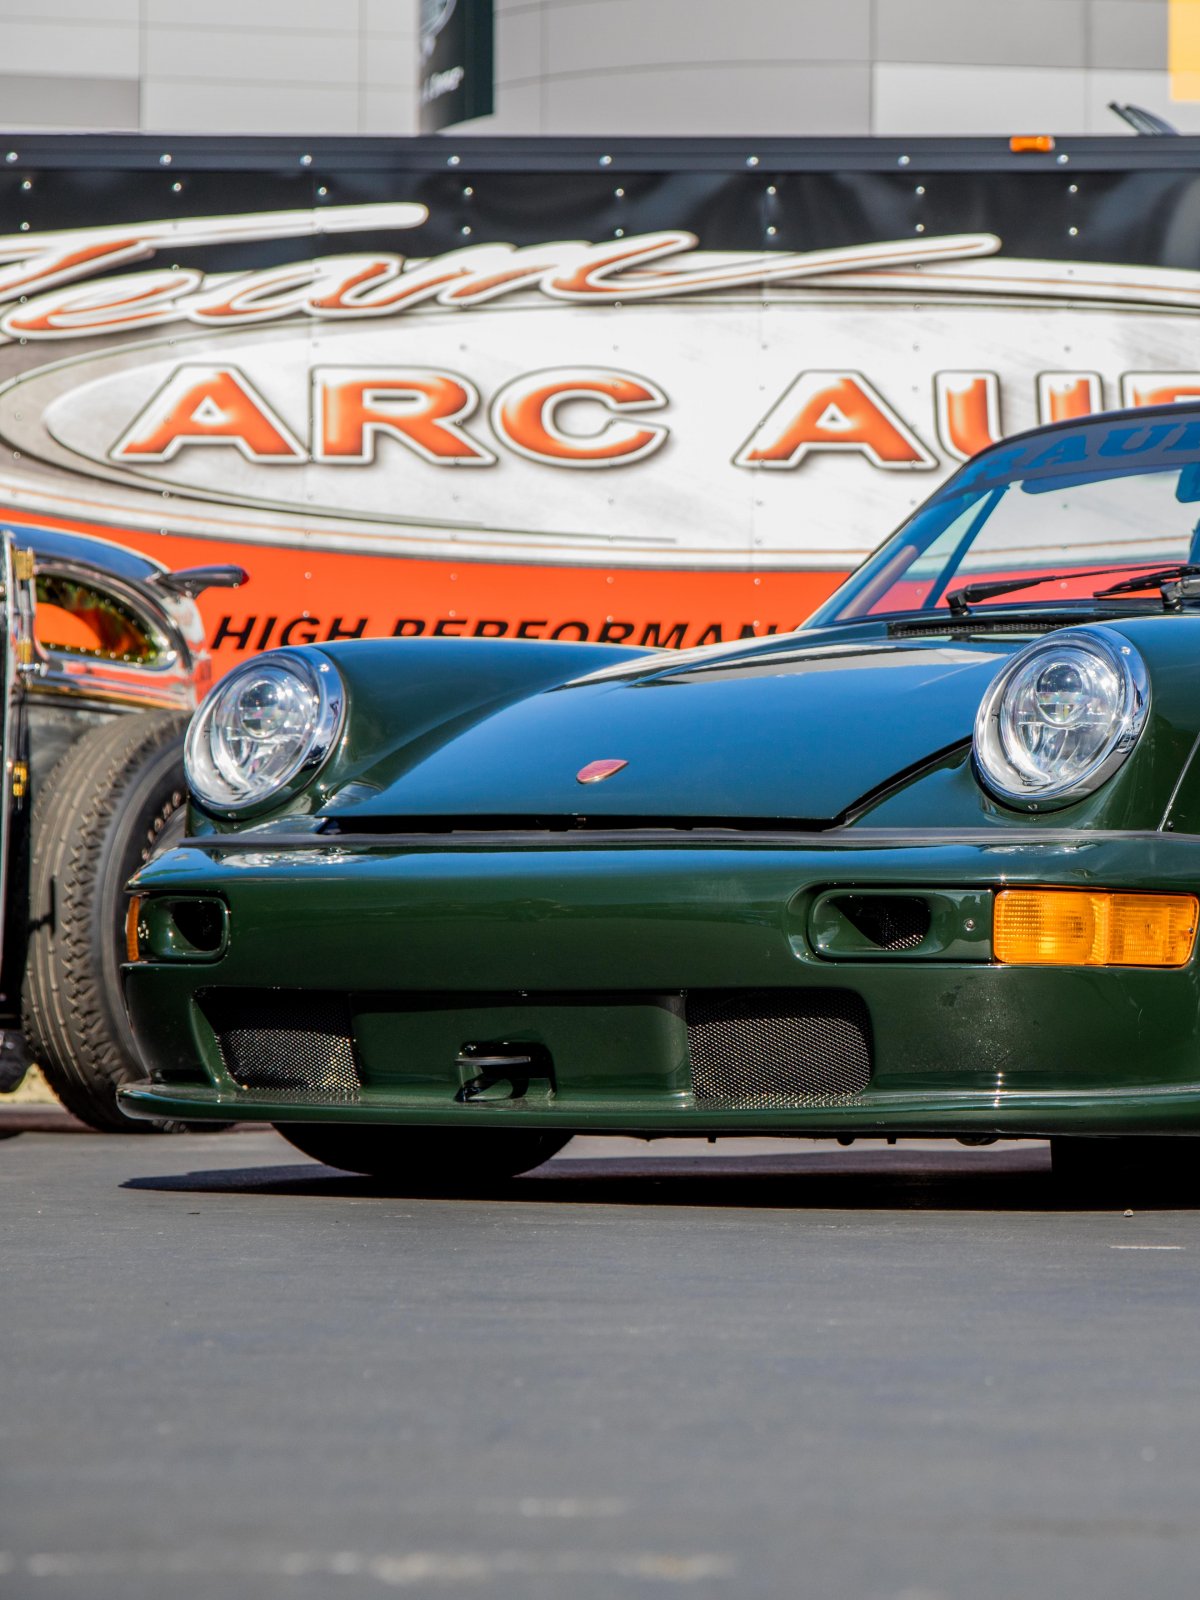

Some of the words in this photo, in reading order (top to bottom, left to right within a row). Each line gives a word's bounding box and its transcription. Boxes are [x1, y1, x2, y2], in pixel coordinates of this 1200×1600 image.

[0, 203, 1000, 338] Team
[109, 363, 670, 468] ARC
[210, 615, 368, 651] HIGH
